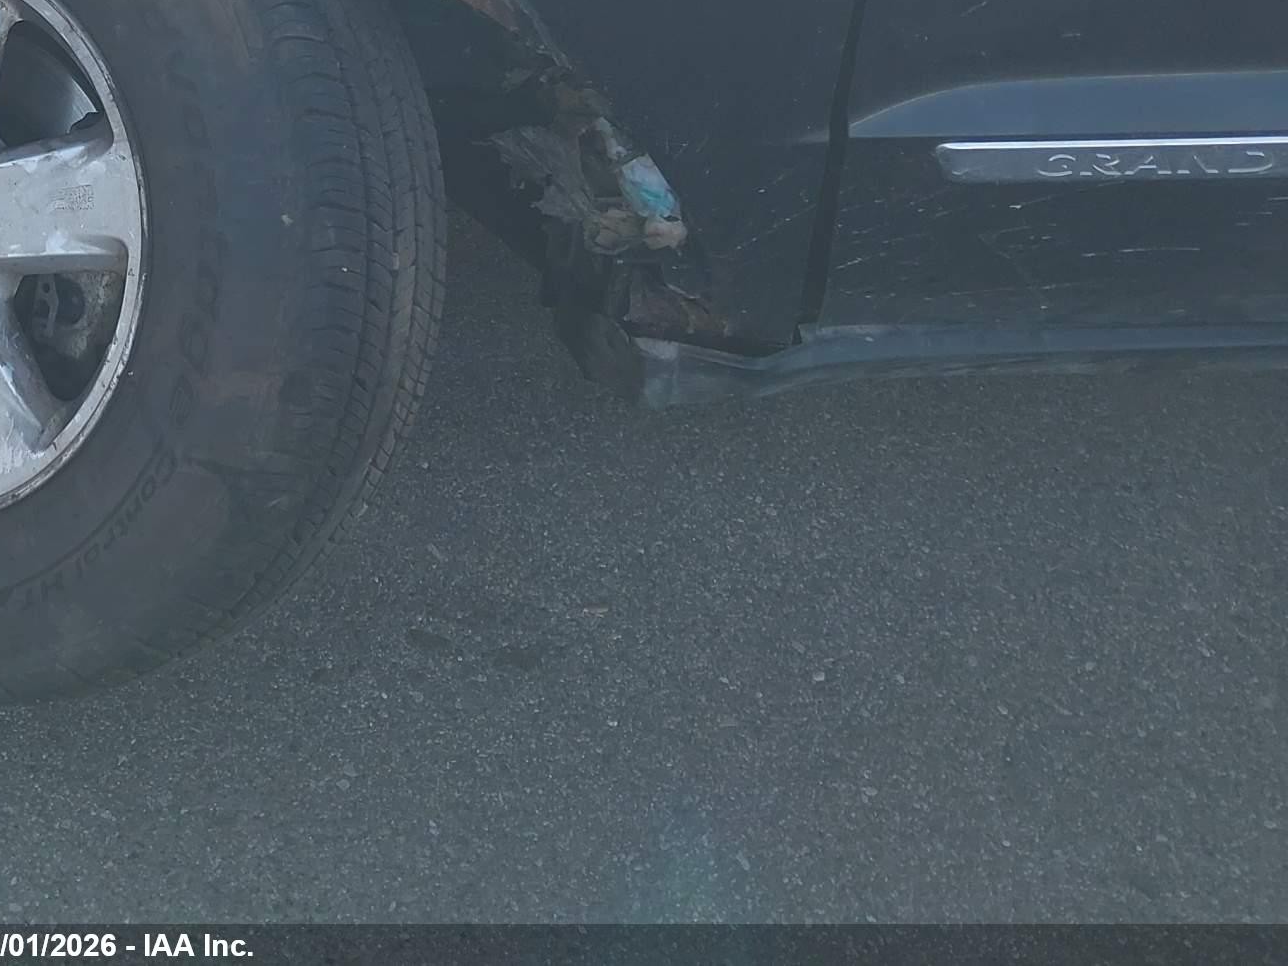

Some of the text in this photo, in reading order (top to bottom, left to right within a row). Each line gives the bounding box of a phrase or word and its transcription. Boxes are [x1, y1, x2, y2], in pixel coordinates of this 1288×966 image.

[1037, 150, 1273, 177] GRAND
[74, 447, 179, 579] Control
[17, 571, 65, 610] HT
